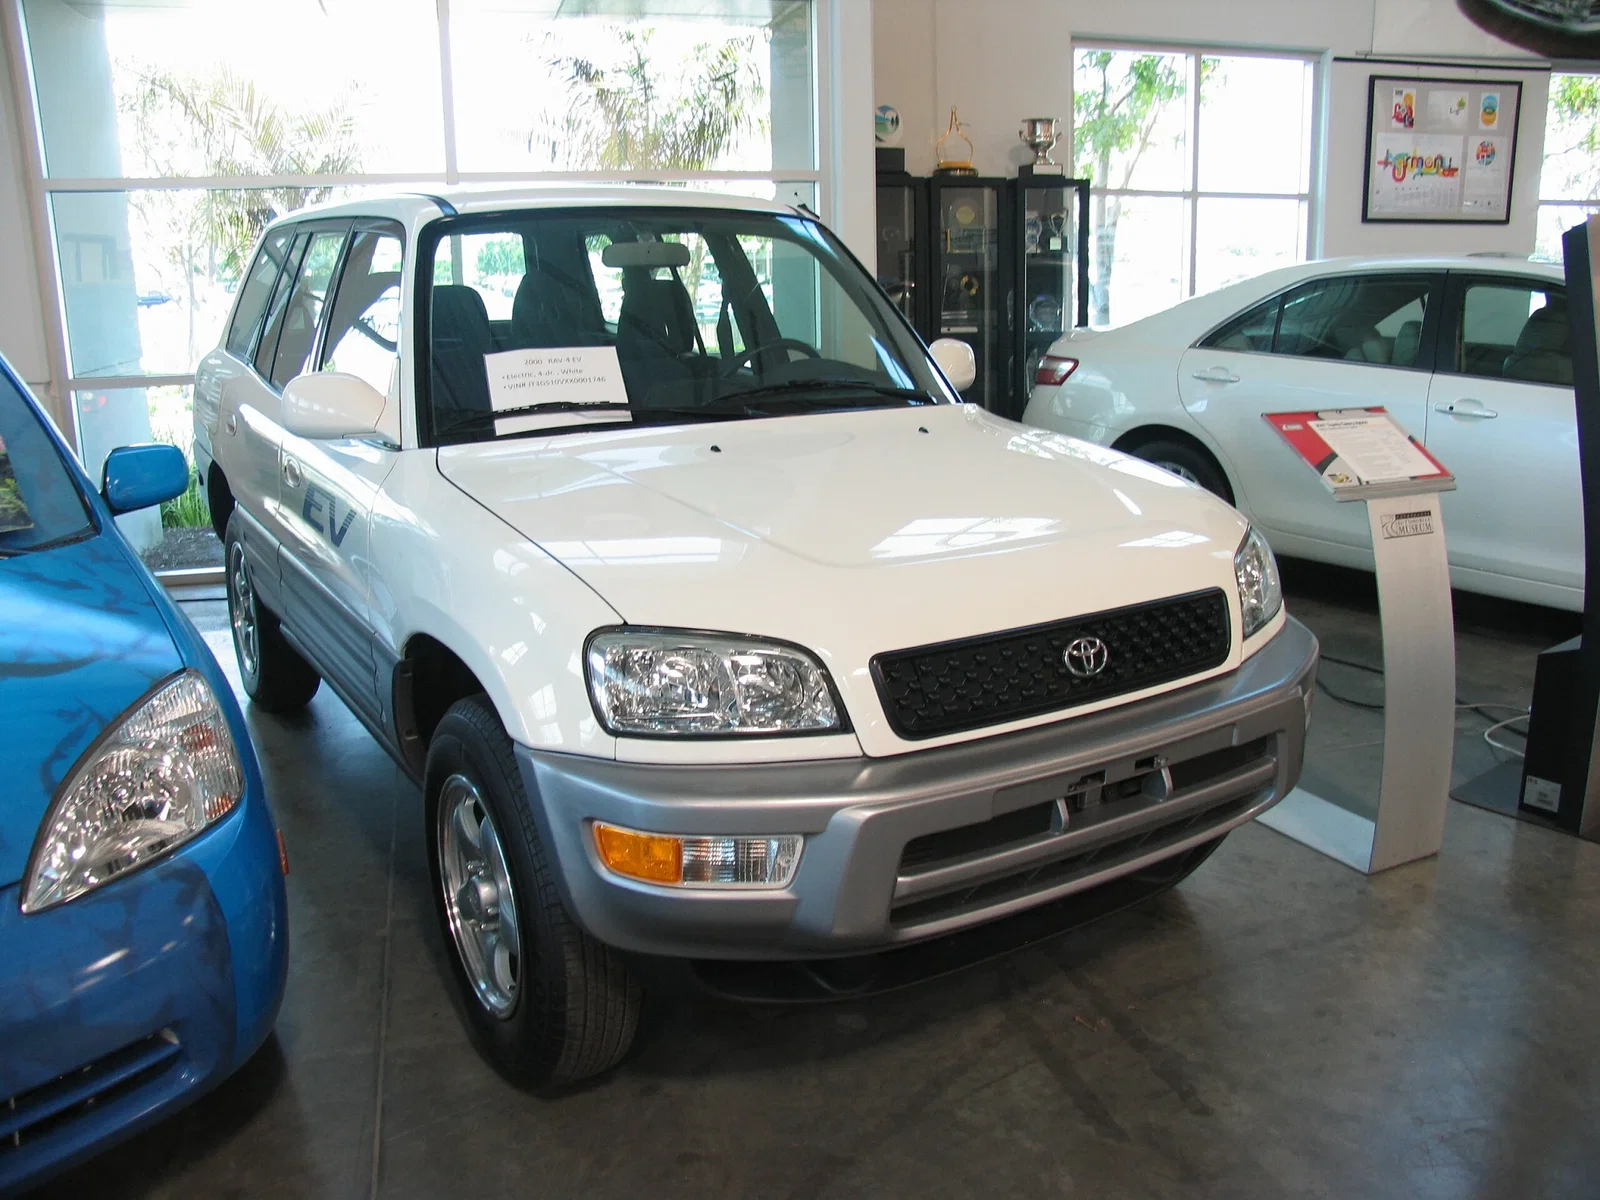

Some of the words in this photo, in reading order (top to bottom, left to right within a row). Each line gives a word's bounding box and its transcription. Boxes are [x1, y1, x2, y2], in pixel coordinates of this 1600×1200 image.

[506, 371, 536, 380] Electric,
[303, 482, 357, 547] EV
[1398, 522, 1432, 534] MUSEUM
